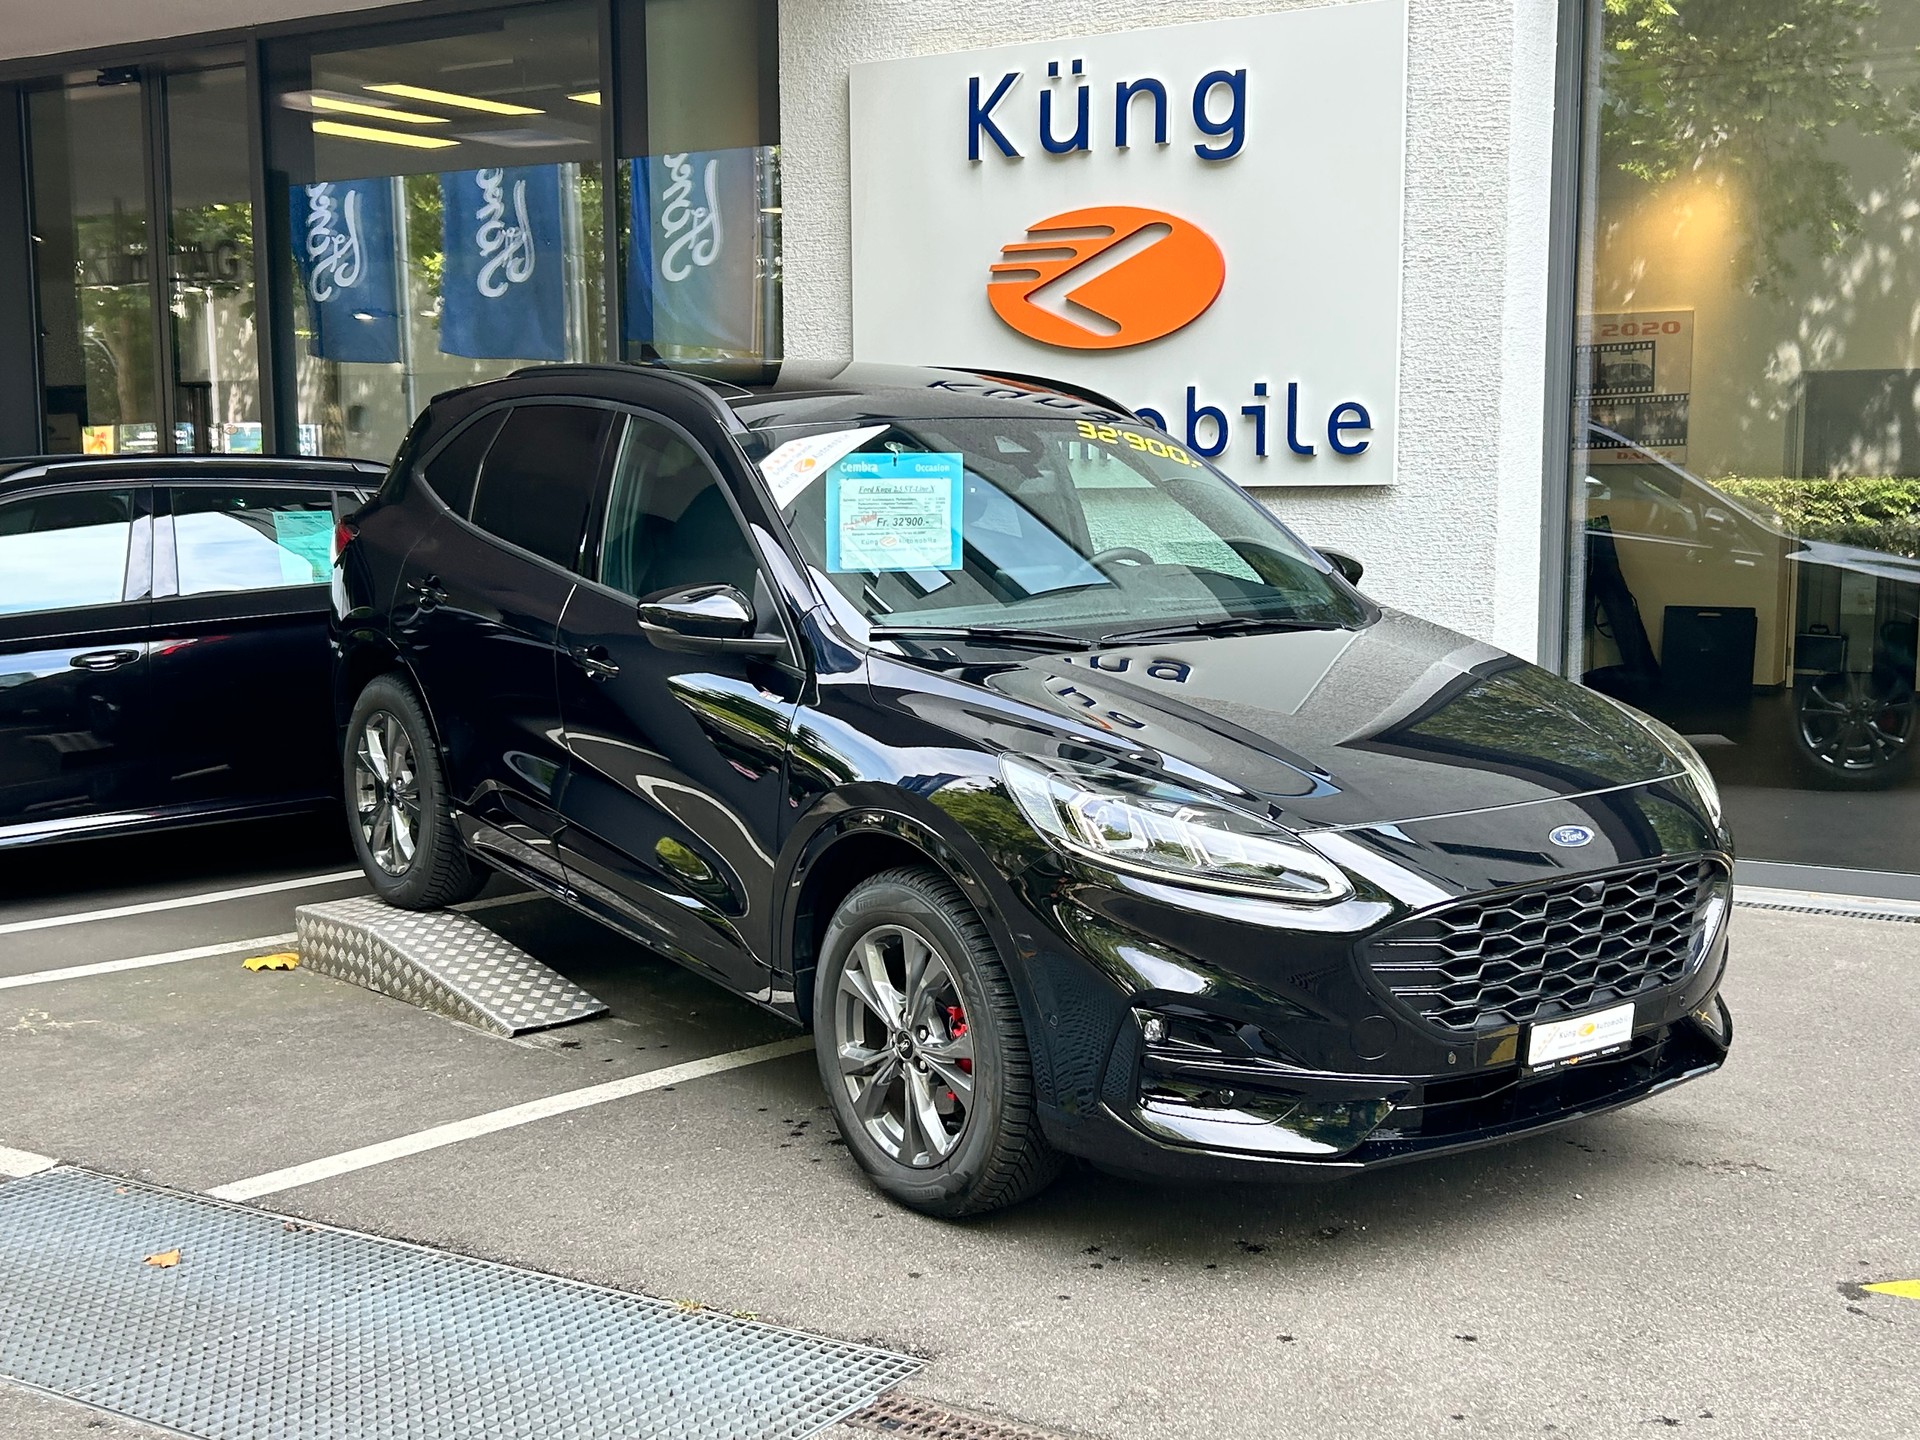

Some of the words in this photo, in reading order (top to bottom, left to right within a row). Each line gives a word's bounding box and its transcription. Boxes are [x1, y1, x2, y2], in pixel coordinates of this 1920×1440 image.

[968, 58, 1250, 161] Küng
[1600, 320, 1681, 338] 2020
[840, 461, 879, 473] Cembra
[915, 463, 950, 473] Occasion
[877, 517, 890, 528] Fr.
[1560, 829, 1584, 842] Ford
